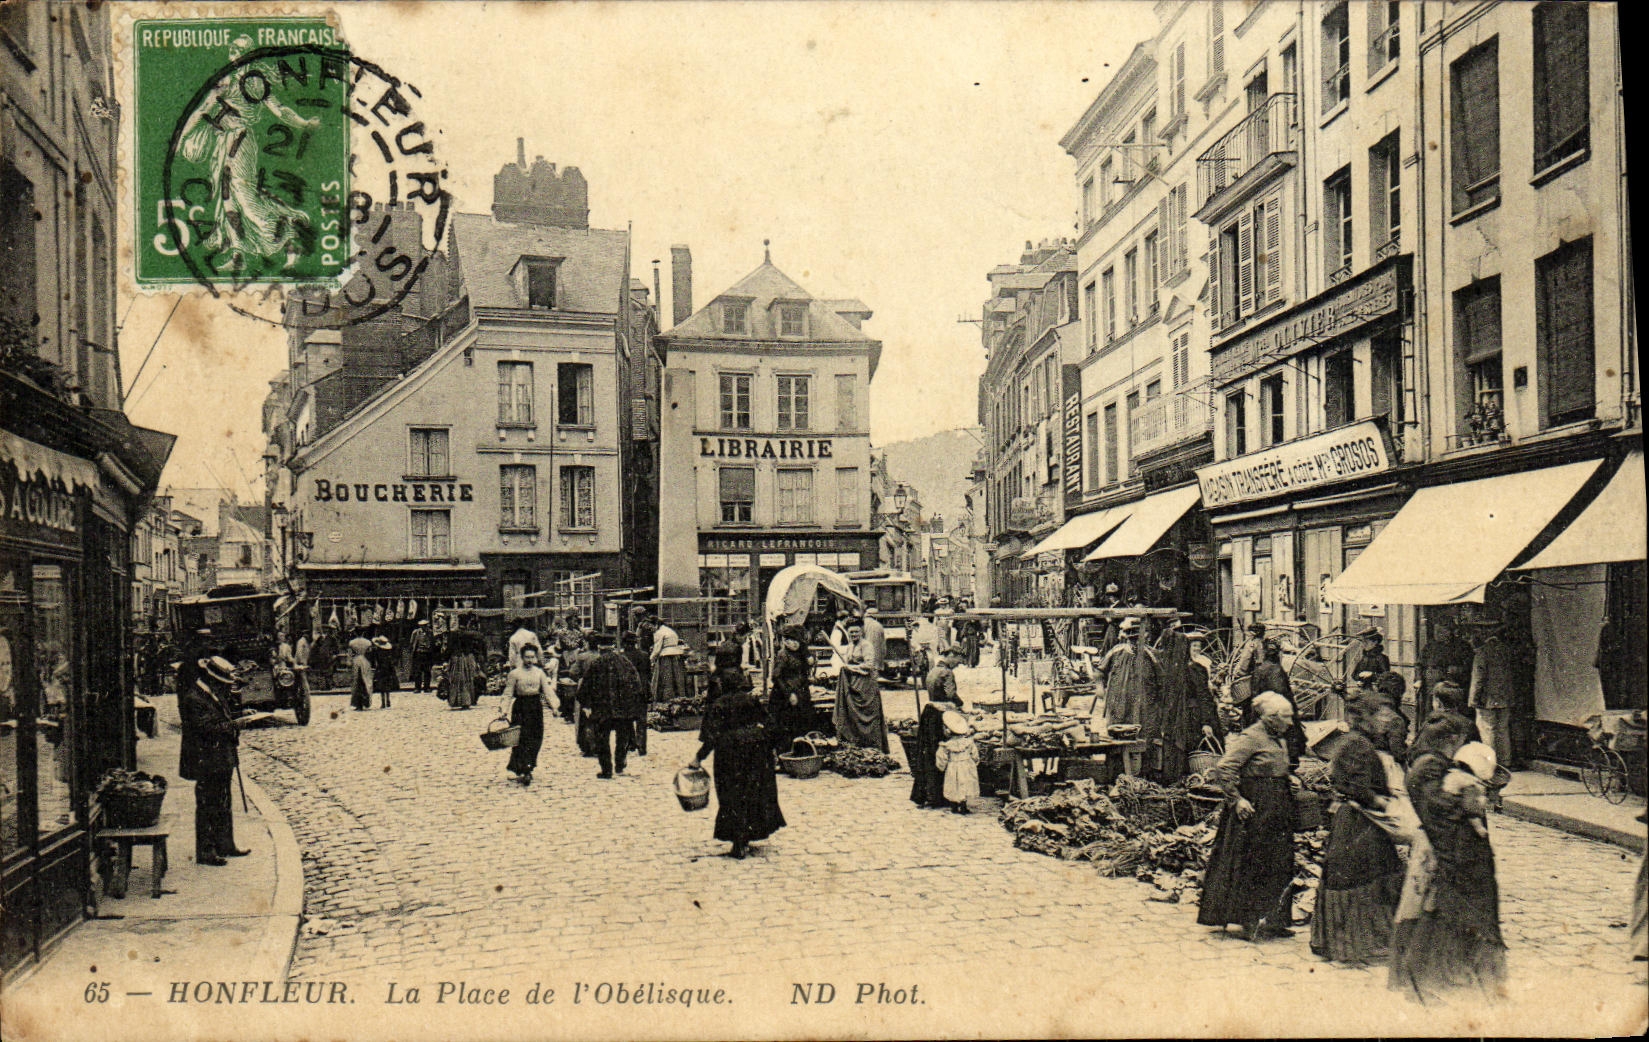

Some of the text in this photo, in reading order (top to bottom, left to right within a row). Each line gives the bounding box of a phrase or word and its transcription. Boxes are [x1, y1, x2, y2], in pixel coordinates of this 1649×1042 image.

[321, 179, 341, 267] POSTES
[700, 437, 833, 459] LIBRAIRIE
[1065, 392, 1082, 494] RESTAURANT
[1329, 436, 1380, 476] GROSOS
[313, 478, 474, 502] BOUCHERIE
[707, 539, 753, 549] RICARD
